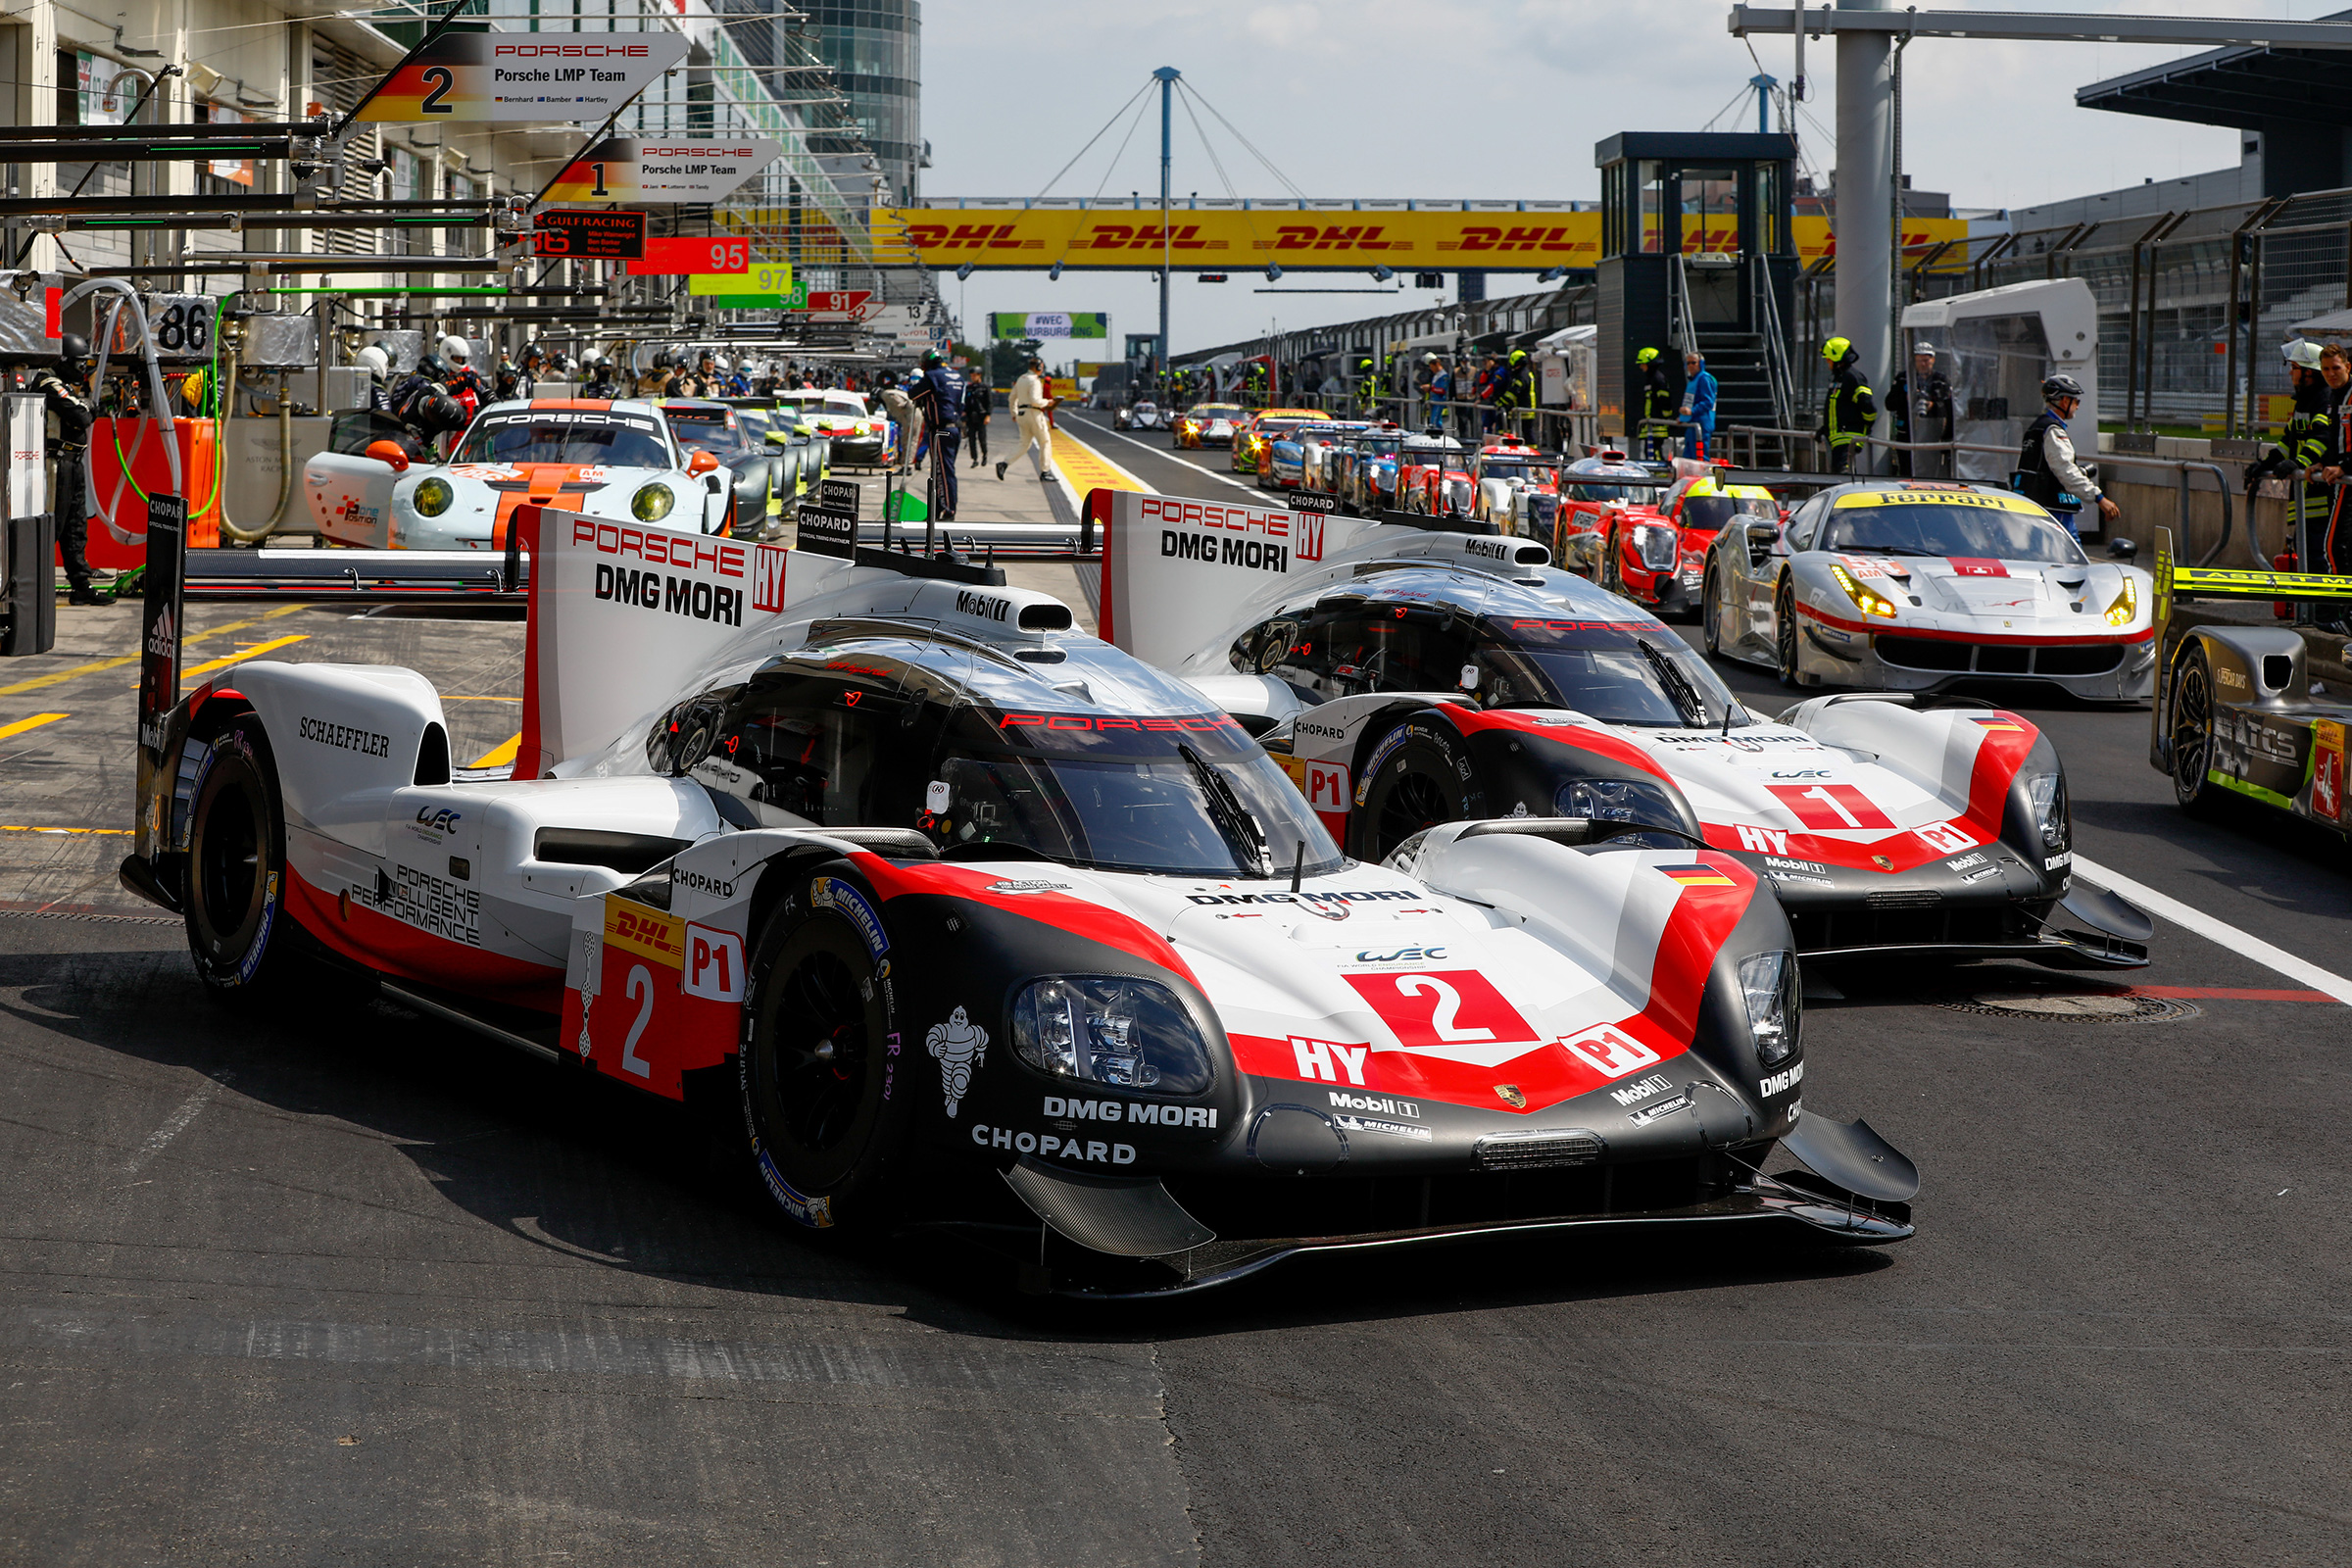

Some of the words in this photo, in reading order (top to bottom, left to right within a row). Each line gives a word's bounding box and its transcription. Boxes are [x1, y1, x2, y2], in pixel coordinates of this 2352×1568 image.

[496, 45, 649, 57] PORSCHE
[495, 68, 550, 82] Porsche
[555, 68, 585, 82] LMP
[589, 68, 625, 82] Team
[421, 66, 454, 114] 2
[642, 148, 753, 157] PORSCHE
[591, 163, 609, 196] 1
[642, 165, 682, 174] Porsche
[686, 165, 708, 174] LMP
[710, 165, 736, 174] Team
[547, 216, 581, 226] GULF
[582, 218, 636, 228] RACING
[906, 224, 1022, 248] DHL
[1091, 224, 1208, 249] DHL
[1275, 225, 1393, 251] DHL
[1458, 226, 1575, 251] DHL
[710, 244, 745, 270] 95
[759, 270, 787, 290] 97
[779, 286, 803, 305] 98
[829, 293, 850, 311] 91
[906, 306, 920, 318] 13
[1035, 315, 1062, 325] #WEC
[157, 304, 207, 350] 86
[931, 328, 939, 338] 8
[483, 414, 655, 432] PORSCHE
[14, 450, 40, 461] PORSCHE
[150, 500, 182, 518] CHOPAR
[1290, 494, 1335, 510] CHOPARD
[1879, 491, 2007, 510] Ferrari
[800, 513, 852, 531] CHOPARD
[1142, 498, 1289, 537] PORSCHE
[1297, 513, 1324, 559] HY
[829, 536, 851, 545] PARTNER
[1161, 529, 1217, 563] DMG
[1222, 538, 1288, 573] MORI
[1465, 538, 1495, 559] Mobil
[572, 518, 745, 578] PORSCHE
[754, 547, 785, 608] HY
[1858, 569, 1884, 579] AM
[2206, 572, 2312, 582] ASSET
[595, 563, 660, 610] DMG
[664, 575, 743, 627] MORI
[956, 590, 994, 619] Mobil
[148, 637, 174, 659] adidas
[299, 715, 390, 759] SCHAEFFLER
[1295, 722, 1345, 739] CHOPARD
[2247, 719, 2297, 759] TCS
[1366, 727, 1404, 773] MICHELIN
[1311, 769, 1341, 806] P1
[1801, 786, 1863, 828] 1
[416, 806, 462, 834] WEC
[1738, 826, 1788, 856] HY
[1921, 826, 1970, 848] P1
[1764, 858, 1809, 872] Mobil
[1946, 856, 1974, 871] Mobil
[1972, 867, 1998, 879] MICHELIN
[2044, 854, 2063, 871] DMG
[397, 864, 480, 908] PORSCHE
[672, 868, 733, 898] CHOPARD
[1789, 874, 1833, 887] MICHELIN
[1185, 892, 1298, 905] DMG
[1299, 890, 1422, 903] MORI
[352, 883, 481, 946] PERFORMANCE
[835, 887, 884, 954] MICHELIN
[616, 909, 671, 953] DHL
[242, 910, 270, 977] MICHELIN
[1355, 947, 1448, 961] WEC
[692, 936, 732, 993] P1
[1395, 974, 1497, 1042] 2
[622, 964, 655, 1079] 2
[886, 1032, 901, 1056] FR
[1574, 1031, 1646, 1069] P1
[1290, 1038, 1367, 1086] HY
[1610, 1080, 1657, 1106] Mobil
[1760, 1071, 1788, 1098] DMG
[1043, 1096, 1122, 1121] DMG
[1128, 1102, 1218, 1128] MORI
[1328, 1092, 1396, 1115] Mobil
[1647, 1097, 1688, 1117] MICHELIN
[1363, 1120, 1429, 1137] MICHELIN
[971, 1124, 1137, 1164] CHOPARD
[760, 1161, 806, 1220] MICHELIN
